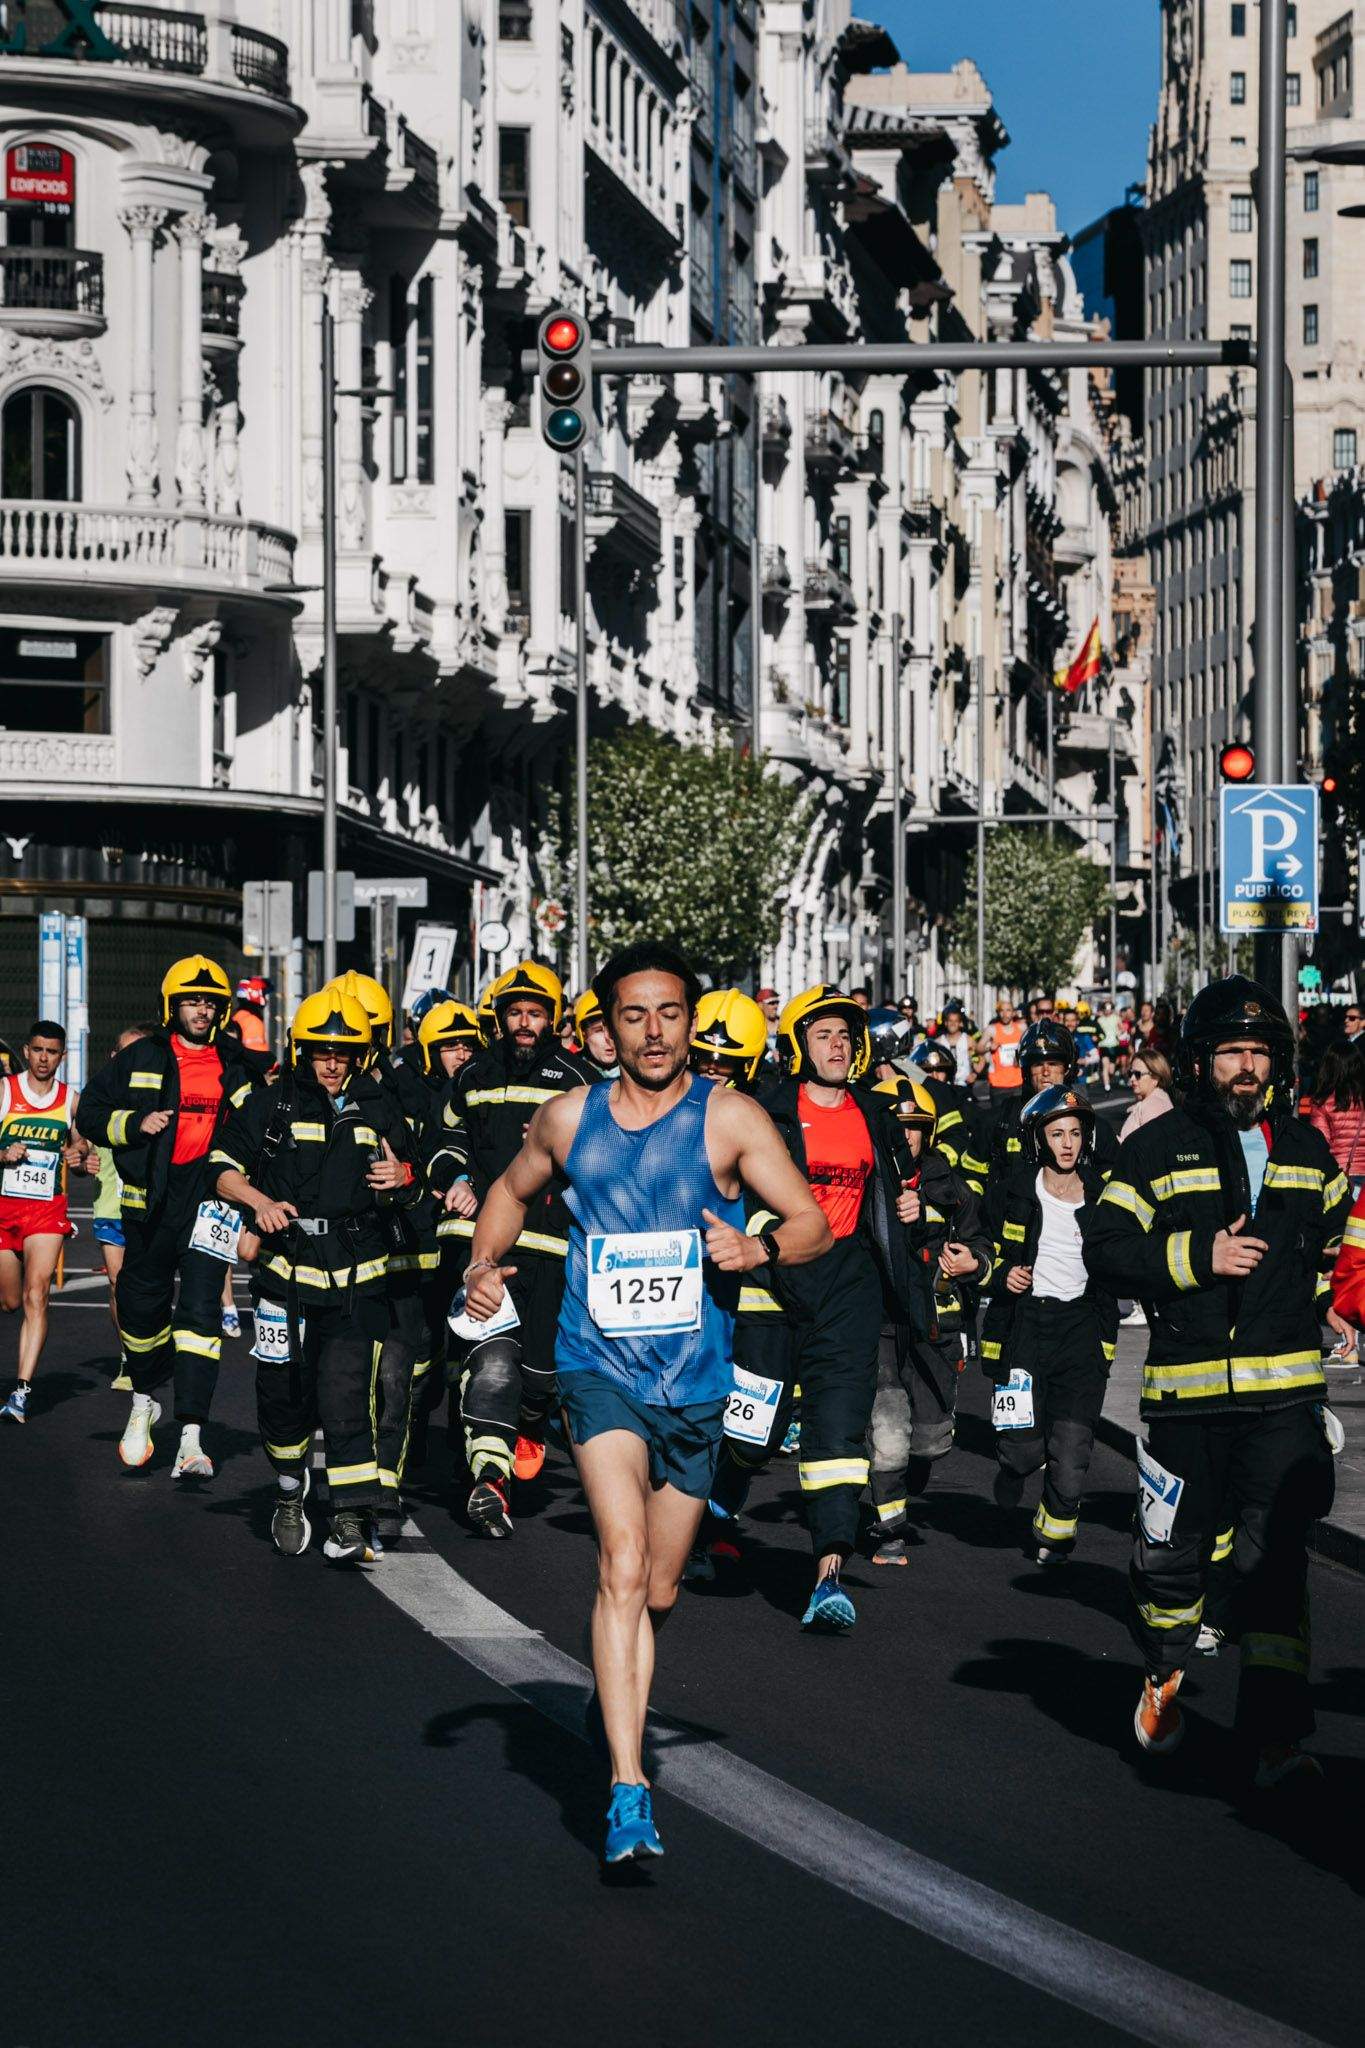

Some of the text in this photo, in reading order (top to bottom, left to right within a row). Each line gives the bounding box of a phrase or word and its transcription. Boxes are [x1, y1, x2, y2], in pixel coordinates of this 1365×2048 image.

[10, 176, 68, 195] EDIFICIOS
[1242, 809, 1298, 882] P
[1232, 909, 1264, 918] PLAZA
[1287, 909, 1306, 918] REY
[14, 1169, 48, 1185] 1548
[210, 1224, 230, 1244] 923
[621, 1247, 681, 1260] BOMBEROS
[610, 1276, 684, 1305] 1257
